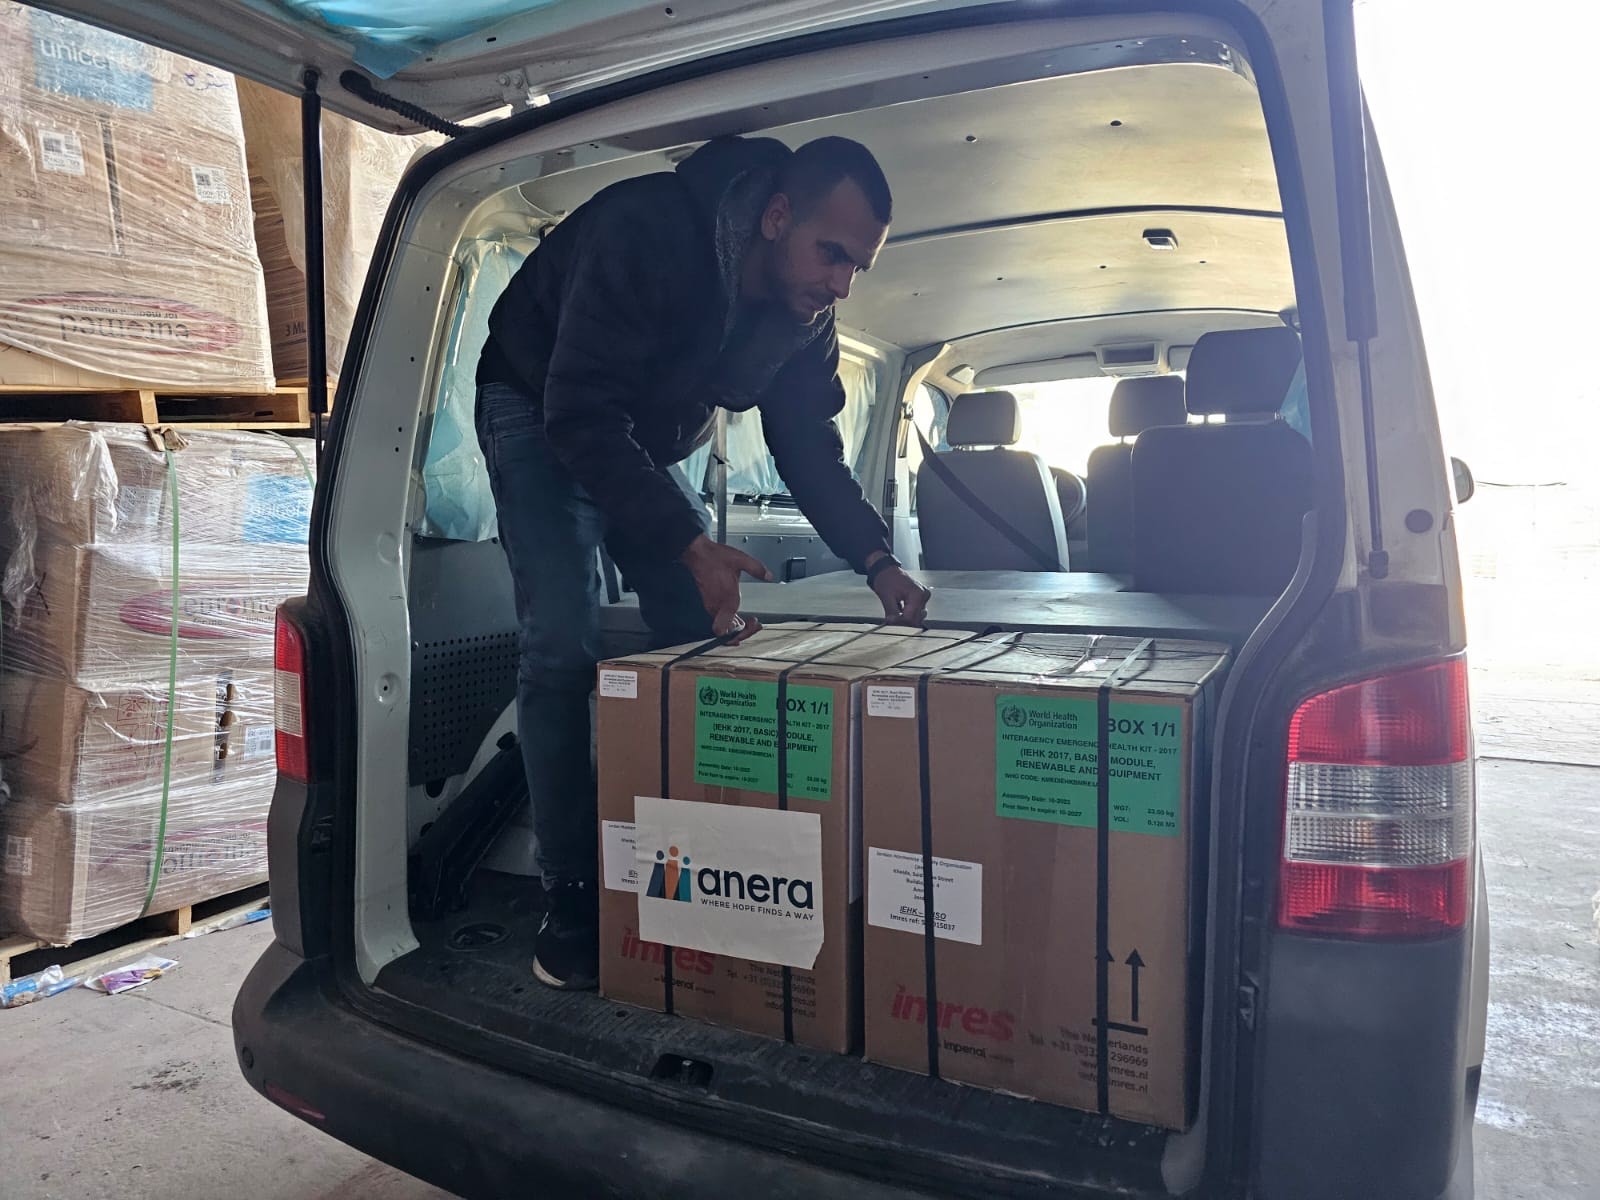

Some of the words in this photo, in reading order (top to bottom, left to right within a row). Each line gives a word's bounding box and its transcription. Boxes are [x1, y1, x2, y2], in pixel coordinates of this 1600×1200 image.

[719, 698, 756, 707] Organization
[720, 690, 737, 698] World
[738, 691, 757, 701] Health
[810, 702, 829, 715] 1/1
[700, 711, 739, 721] INTERAGENCY
[740, 715, 776, 724] EMERGENCY
[1029, 709, 1051, 721] World
[1053, 712, 1078, 724] Health
[1028, 718, 1078, 732] Organization
[1151, 721, 1176, 738] 1/1
[709, 733, 755, 745] RENEWABLE
[756, 739, 773, 747] AND
[713, 723, 732, 733] (IEHK
[734, 726, 752, 736] 2017,
[786, 731, 815, 743] ODULE,
[1002, 733, 1054, 745] INTERAGENCY
[1056, 738, 1099, 749] EMERGENC
[1139, 746, 1153, 755] KIT
[1159, 748, 1178, 757] 2017
[1020, 747, 1046, 760] (IEHK
[1048, 750, 1072, 763] 2017,
[1110, 758, 1157, 770] MODULE,
[1015, 759, 1076, 774] RENEWABLE
[697, 867, 815, 910] anera
[701, 898, 731, 909] WHERE
[733, 903, 756, 913] HOPE
[758, 906, 784, 918] FINDS
[785, 910, 792, 919] A
[794, 912, 815, 922] WAY
